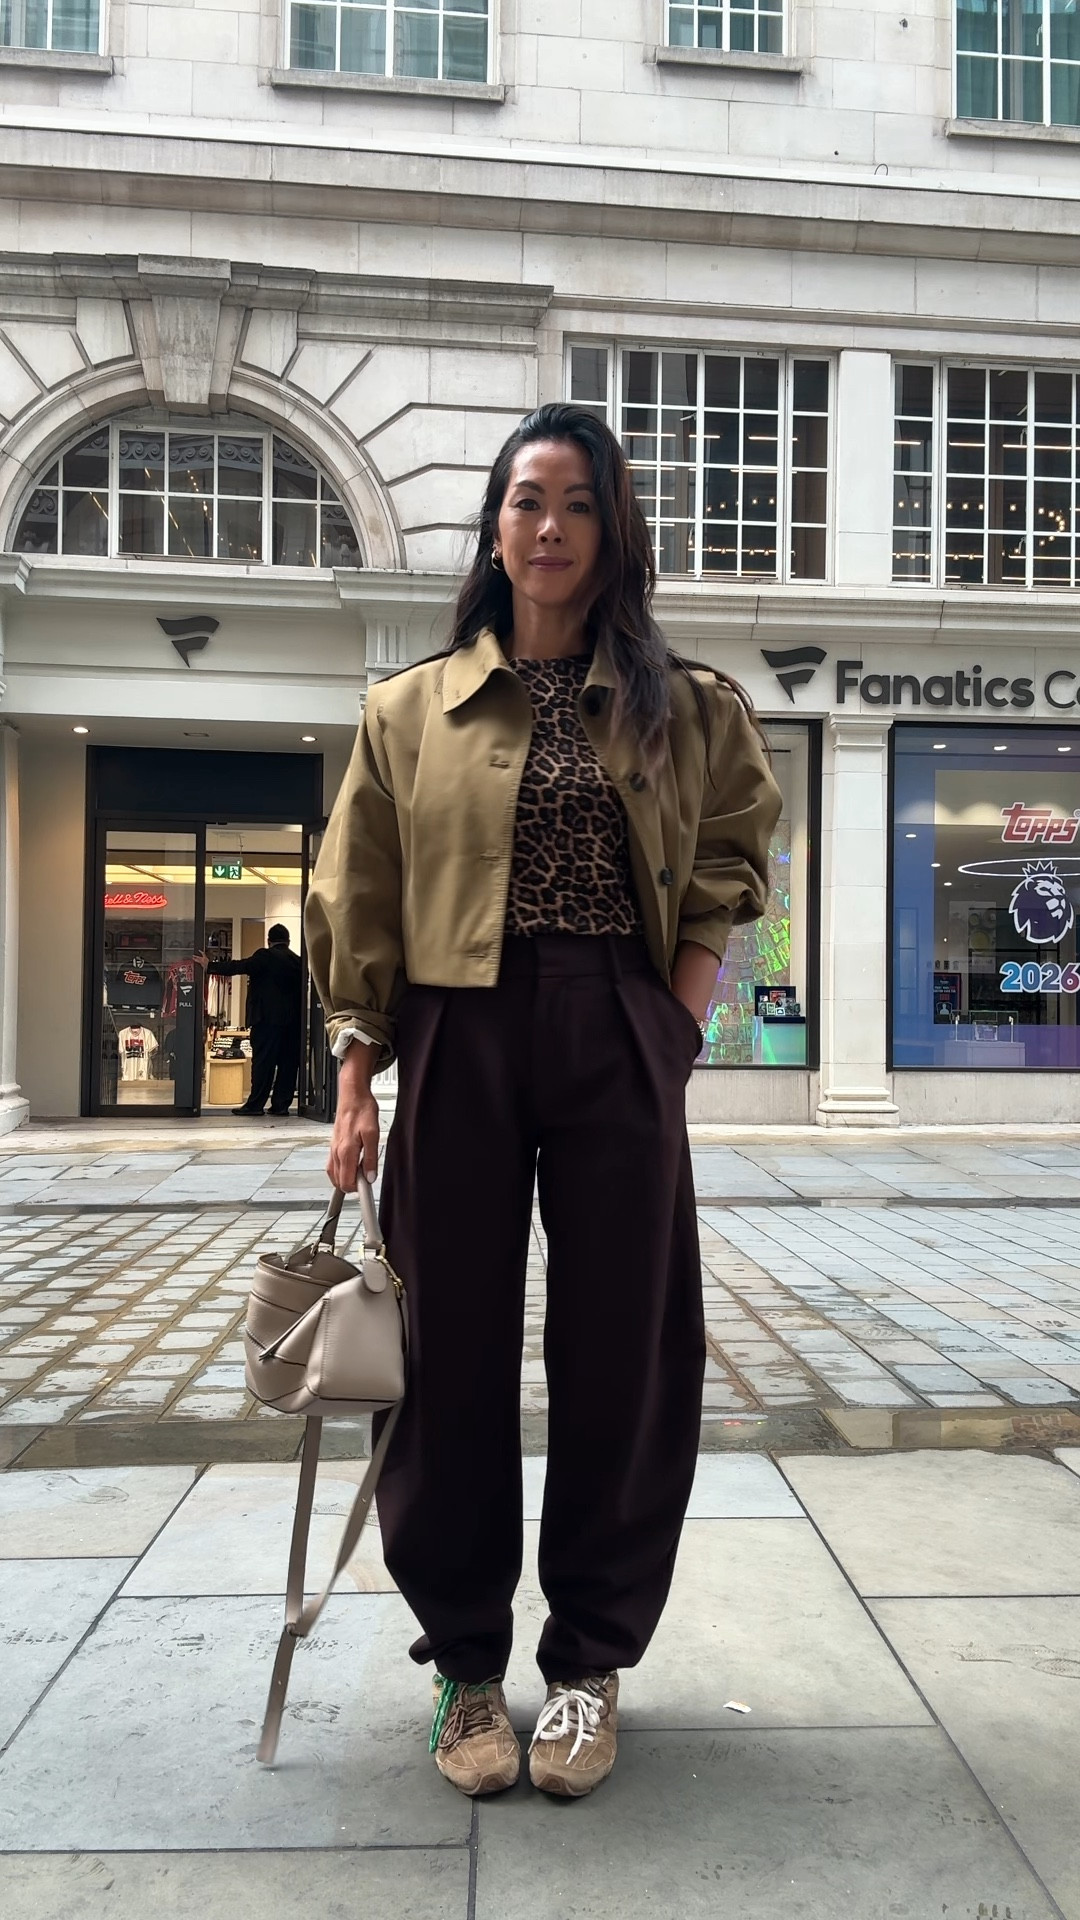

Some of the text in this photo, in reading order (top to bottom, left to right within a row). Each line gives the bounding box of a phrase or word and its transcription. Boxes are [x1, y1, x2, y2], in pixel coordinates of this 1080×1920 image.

[836, 660, 1080, 709] Fanatics C
[999, 961, 1080, 993] 2026
